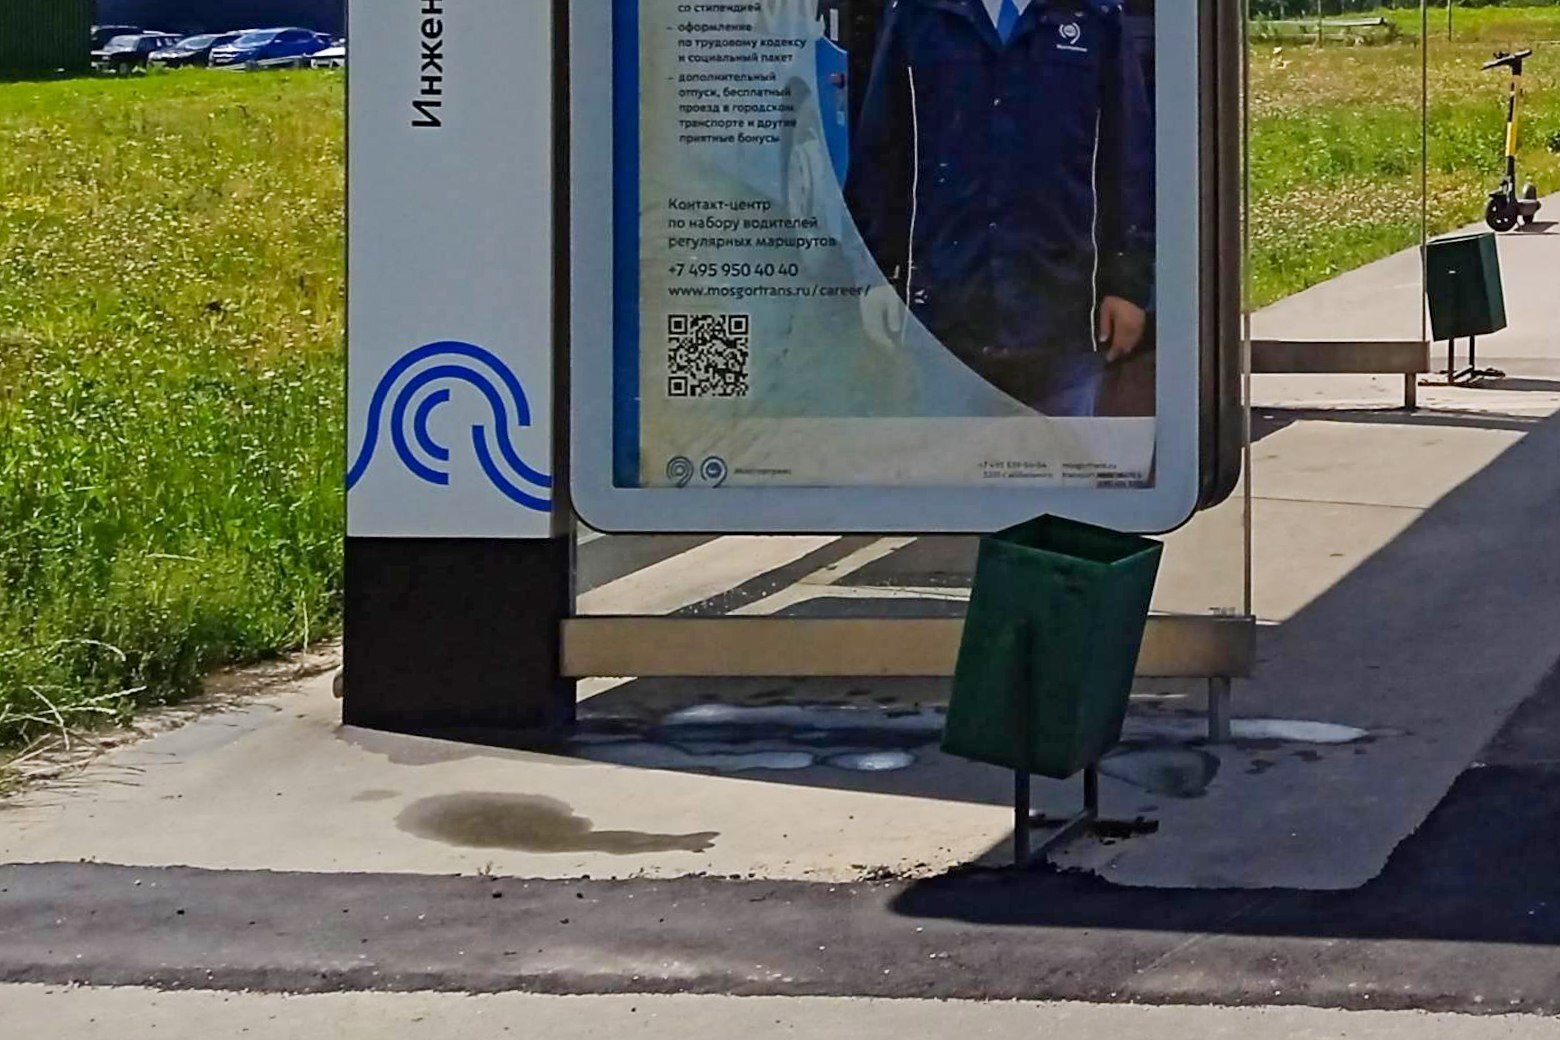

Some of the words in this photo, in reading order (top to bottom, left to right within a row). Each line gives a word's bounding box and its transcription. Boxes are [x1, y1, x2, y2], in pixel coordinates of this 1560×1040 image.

[678, 4, 691, 12] со
[694, 3, 761, 14] стипендией
[678, 22, 752, 34] оформление
[678, 39, 692, 47] по
[695, 39, 757, 50] трудовому
[760, 39, 807, 50] кодексу
[688, 52, 758, 64] социальный
[761, 54, 793, 62] пакет
[678, 72, 776, 82] дополнительный
[678, 88, 721, 98] отпуск,
[723, 87, 792, 97] бесплатный
[679, 104, 719, 114] проезд
[733, 103, 794, 115] городском
[679, 119, 745, 130] транспорте
[758, 118, 797, 130] другие
[679, 135, 735, 146] приятные
[738, 134, 780, 145] бонусы
[669, 199, 771, 212] Контакт-центр
[669, 219, 685, 228] по
[689, 216, 739, 231] набору
[744, 216, 818, 229] водителей
[669, 237, 752, 250] регулярных
[756, 237, 836, 250] маршрутов
[669, 264, 685, 277] +7
[689, 263, 718, 277] 495
[722, 263, 750, 277] 950
[755, 263, 775, 277] 40
[778, 263, 799, 277] 40
[669, 284, 871, 299] www.mosgortrans.ru/career/
